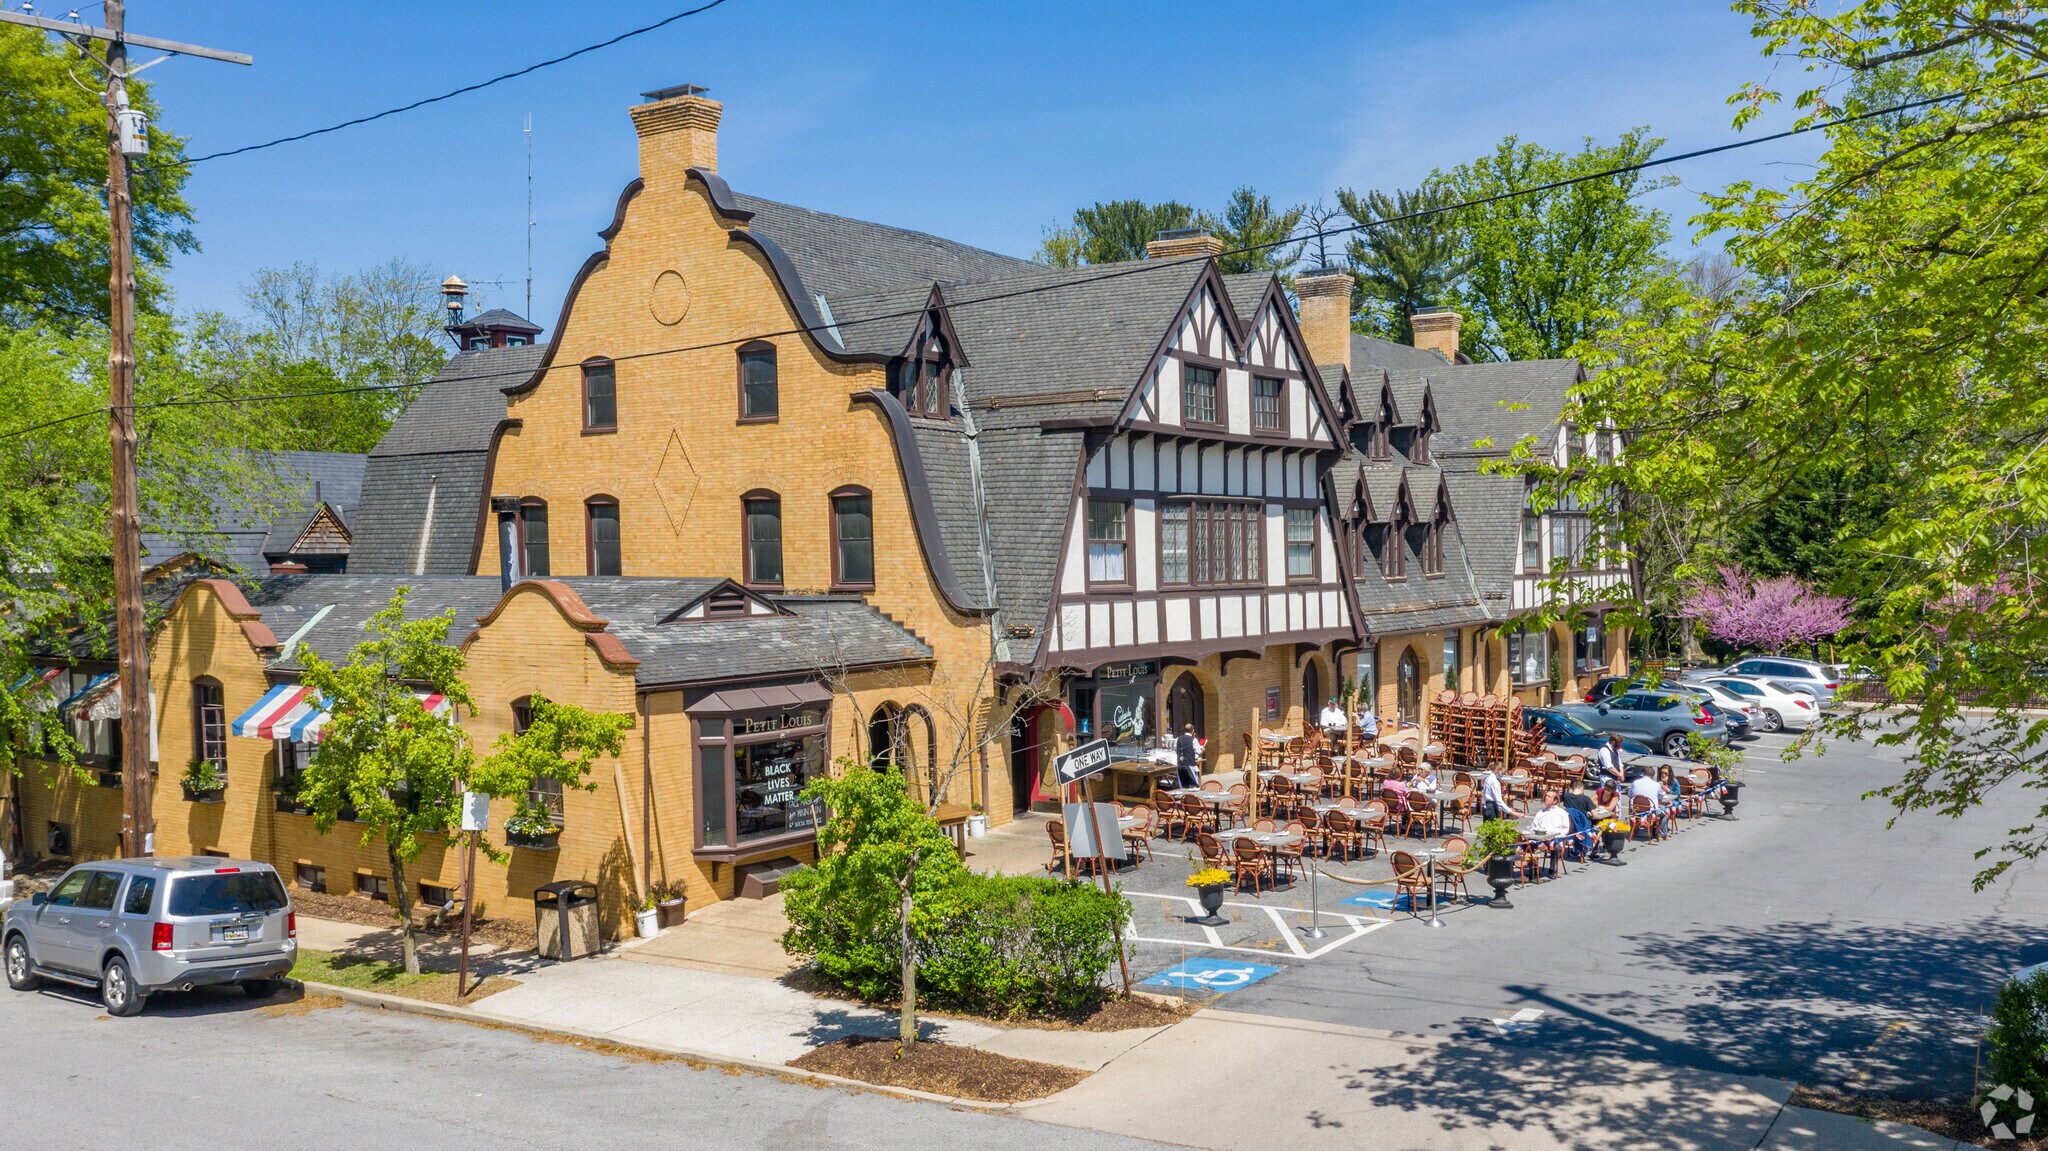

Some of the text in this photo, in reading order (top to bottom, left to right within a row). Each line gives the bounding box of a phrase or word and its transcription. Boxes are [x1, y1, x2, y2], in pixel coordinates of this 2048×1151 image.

[1107, 664, 1148, 678] PETIT LOUIS
[745, 714, 812, 733] PETIT LOUIS
[1074, 749, 1105, 770] ONE WAY
[765, 763, 791, 776] BLACK
[767, 777, 790, 790] LIVES
[764, 791, 794, 805] MATTER
